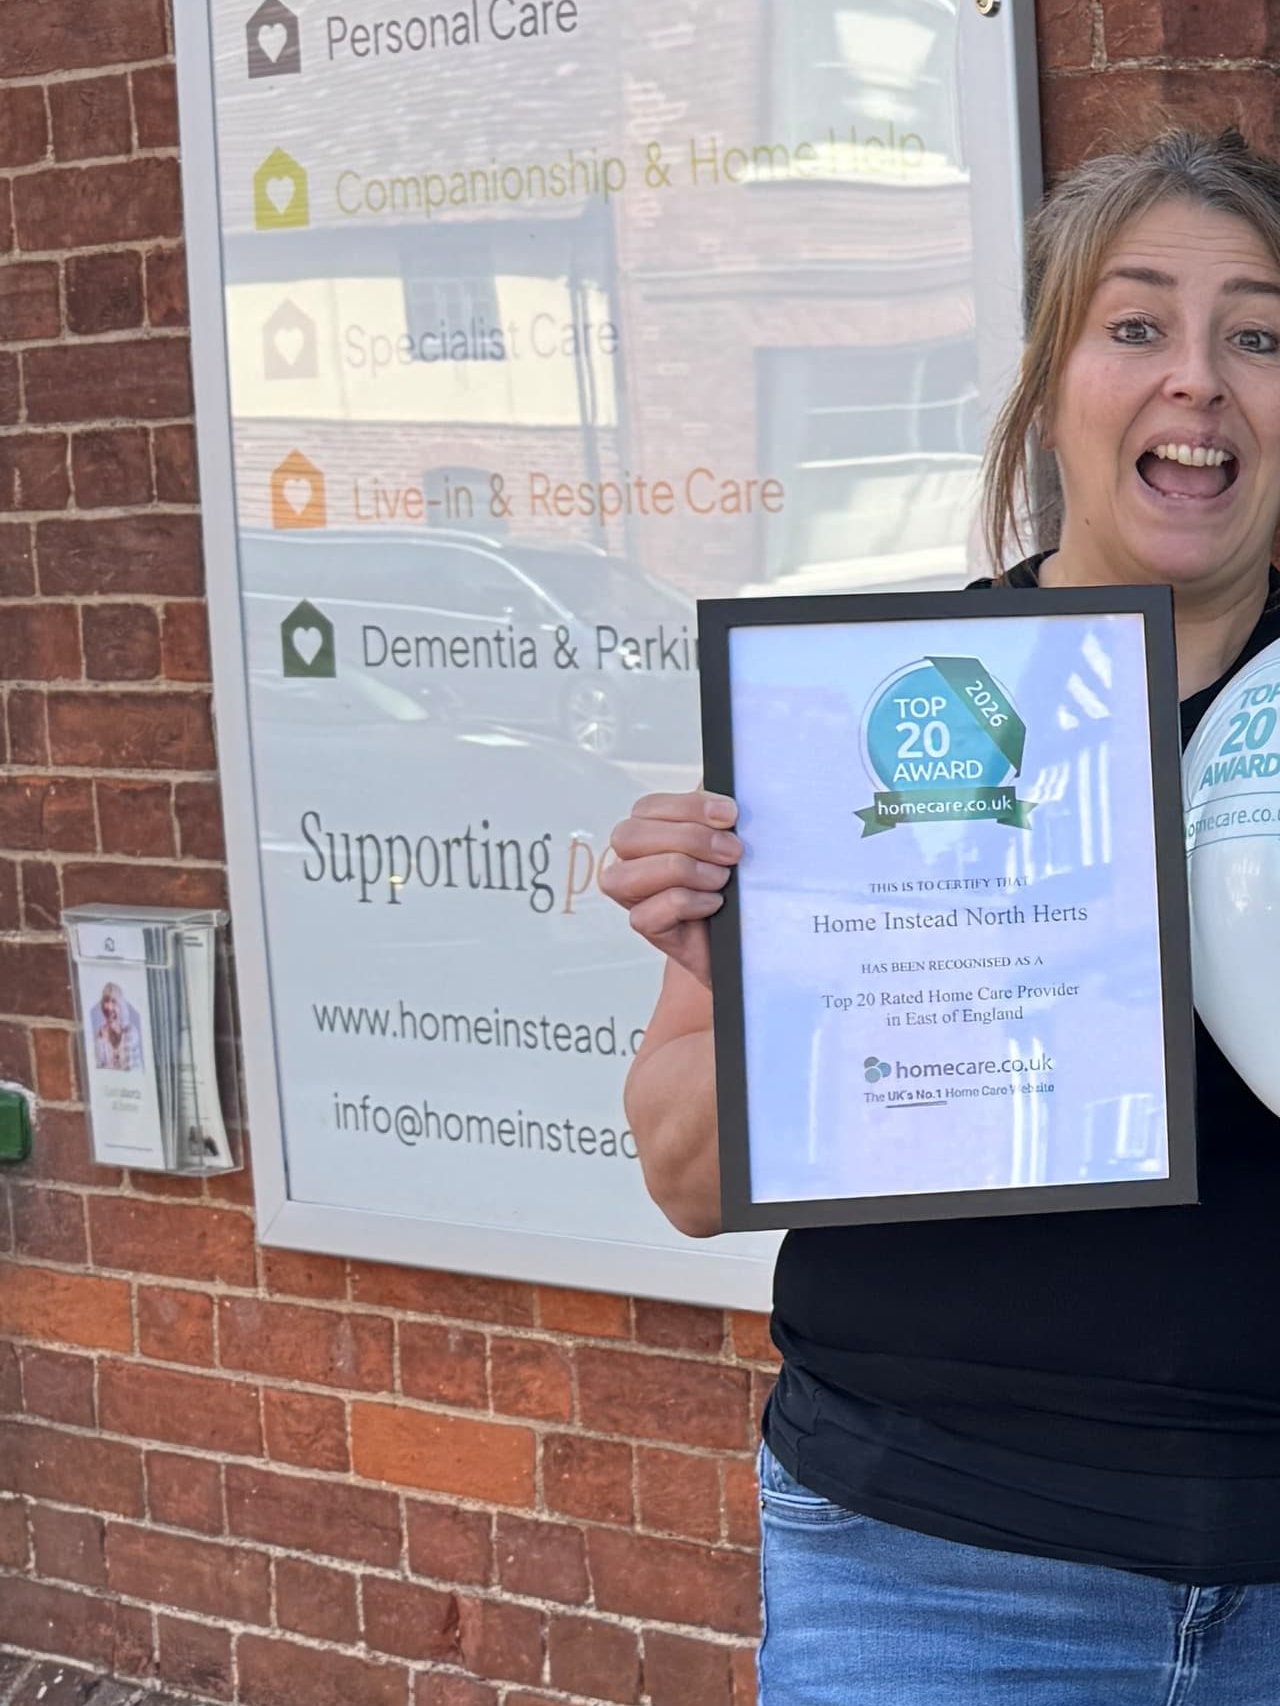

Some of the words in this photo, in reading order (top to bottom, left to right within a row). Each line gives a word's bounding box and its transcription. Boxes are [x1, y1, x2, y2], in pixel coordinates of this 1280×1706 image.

[336, 148, 625, 216] Companionship
[643, 141, 672, 187] &
[691, 137, 819, 185] Home
[344, 316, 519, 377] Specialist
[530, 313, 618, 359] Care
[354, 476, 473, 521] Live-in
[489, 473, 513, 518] &
[530, 472, 674, 527] Respite
[686, 467, 784, 513] Care
[363, 624, 537, 669] Dementia
[555, 625, 579, 669] &
[597, 624, 699, 670] Parki
[893, 697, 947, 718] TOP
[965, 680, 1008, 727] 2026
[896, 721, 949, 758] 20
[1219, 707, 1277, 756] 20
[893, 760, 983, 783] AWARD
[878, 795, 1013, 815] homecare.co.uk
[300, 811, 553, 913] Supporting
[871, 883, 897, 893] THIS
[902, 882, 913, 892] IS
[917, 880, 934, 891] TO
[937, 878, 990, 890] CERTIFY
[996, 876, 1031, 887] THAT
[813, 914, 876, 933] Home
[884, 909, 957, 930] Instead
[966, 906, 1025, 926] North
[1034, 904, 1088, 923] Herts
[862, 964, 887, 974] HAS
[892, 961, 924, 972] BEEN
[929, 957, 1010, 971] RECOGNISED
[1015, 957, 1031, 966] AS
[822, 994, 852, 1010] Top
[857, 993, 875, 1007] 20
[881, 990, 923, 1005] Rated
[929, 988, 973, 1003] Home
[978, 986, 1012, 1001] Care
[1017, 983, 1079, 998] Provider
[313, 1001, 645, 1056] www.homeinstead.c
[887, 1012, 901, 1026] in
[906, 1011, 937, 1025] East
[942, 1009, 959, 1023] of
[963, 1007, 1023, 1024] England
[896, 1053, 1053, 1079] homecare.co.uk
[864, 1092, 885, 1103] The
[945, 1088, 979, 1098] Home
[982, 1086, 1007, 1096] Care
